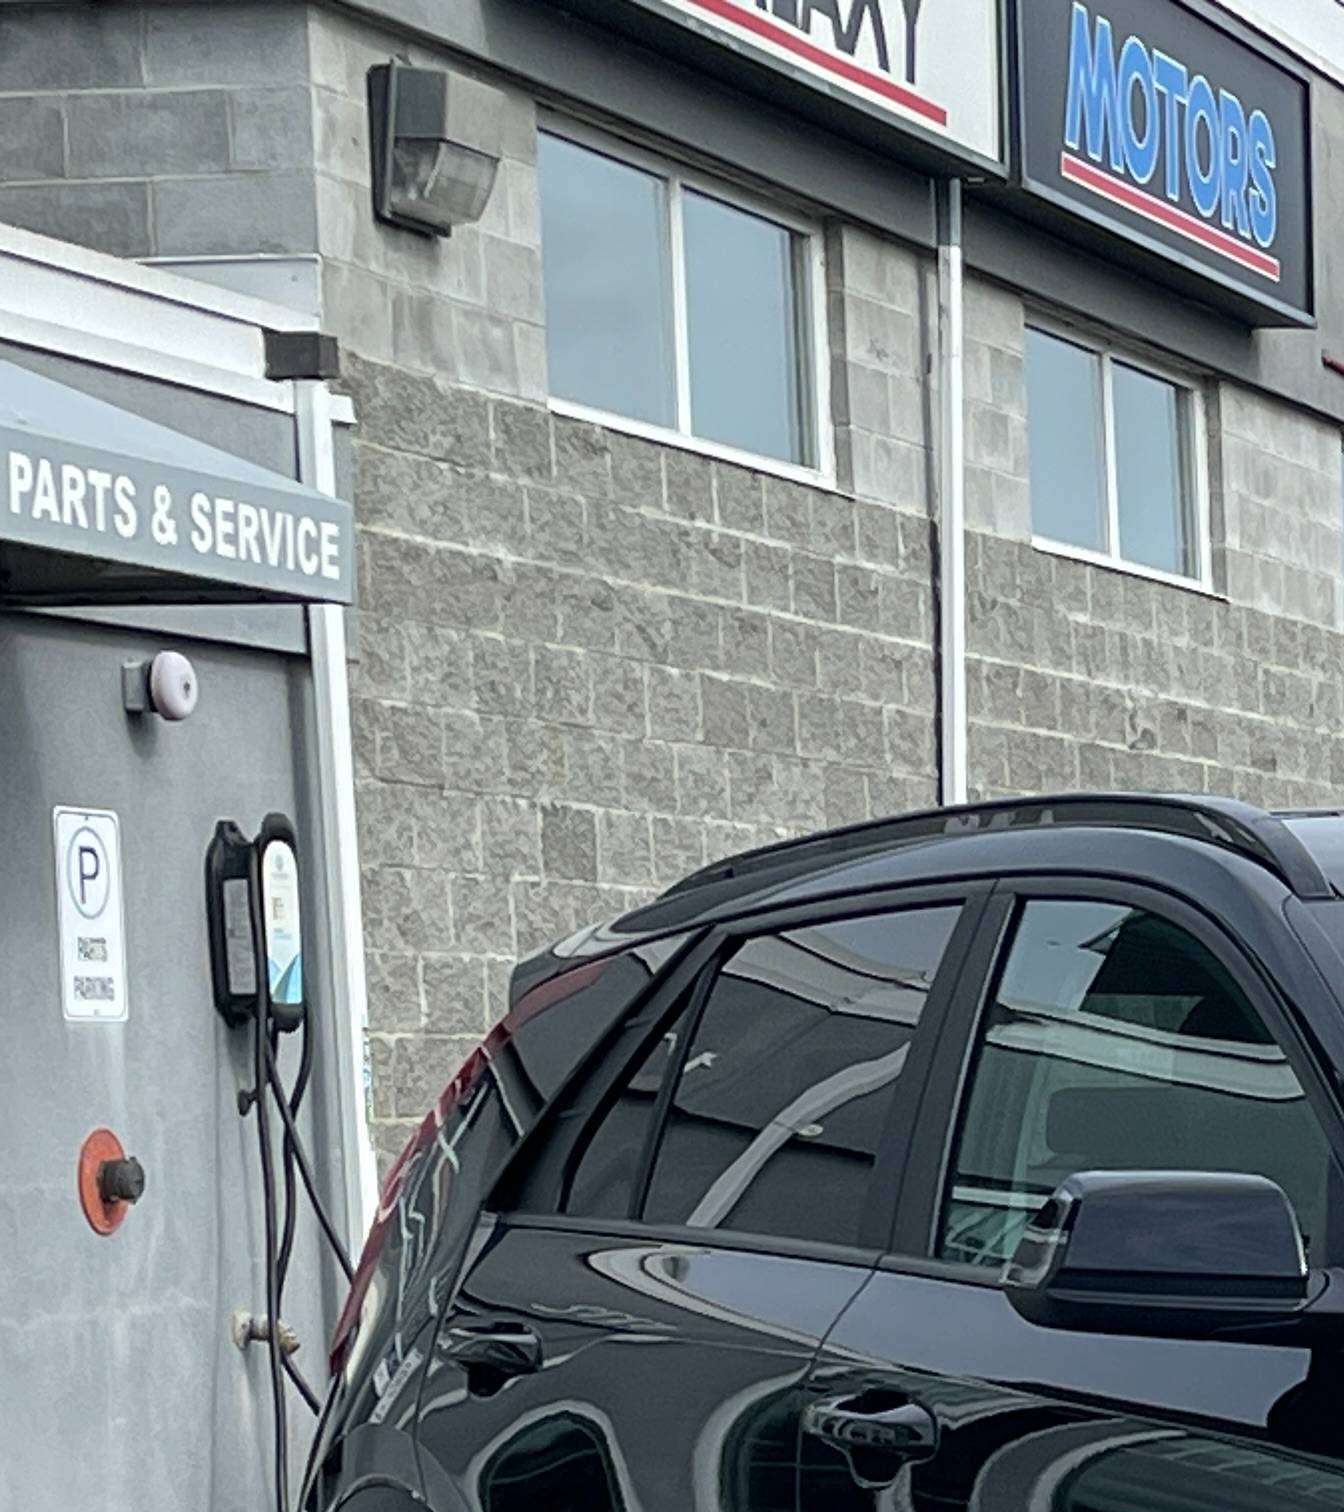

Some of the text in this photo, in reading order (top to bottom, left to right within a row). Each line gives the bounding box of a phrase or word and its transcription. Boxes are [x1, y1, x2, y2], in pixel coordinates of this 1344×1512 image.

[1064, 1, 1277, 248] MOTORS
[8, 451, 341, 581] PARTS & SERVICE
